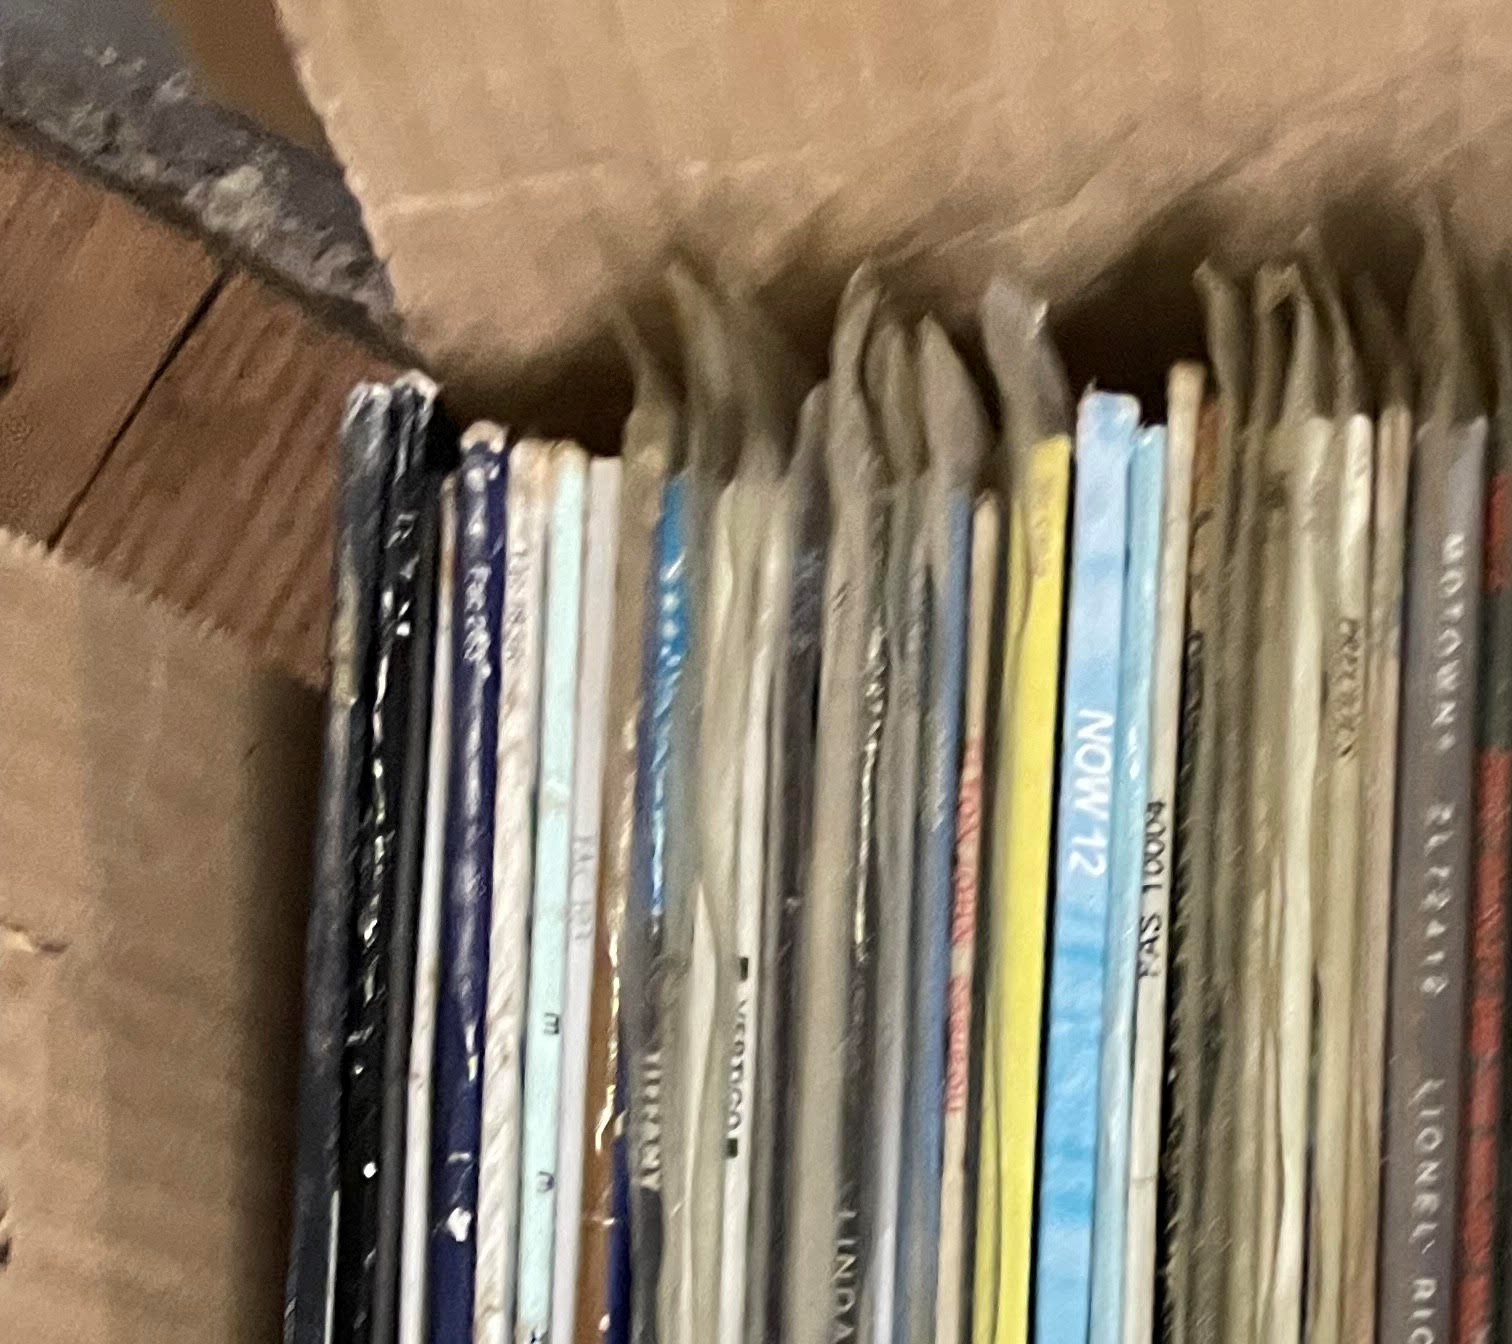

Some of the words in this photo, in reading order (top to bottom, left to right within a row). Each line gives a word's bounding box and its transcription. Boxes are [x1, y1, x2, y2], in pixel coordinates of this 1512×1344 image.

[1073, 709, 1115, 820] NOW
[1069, 831, 1107, 876] 12
[1408, 1079, 1446, 1240] LIONEL
